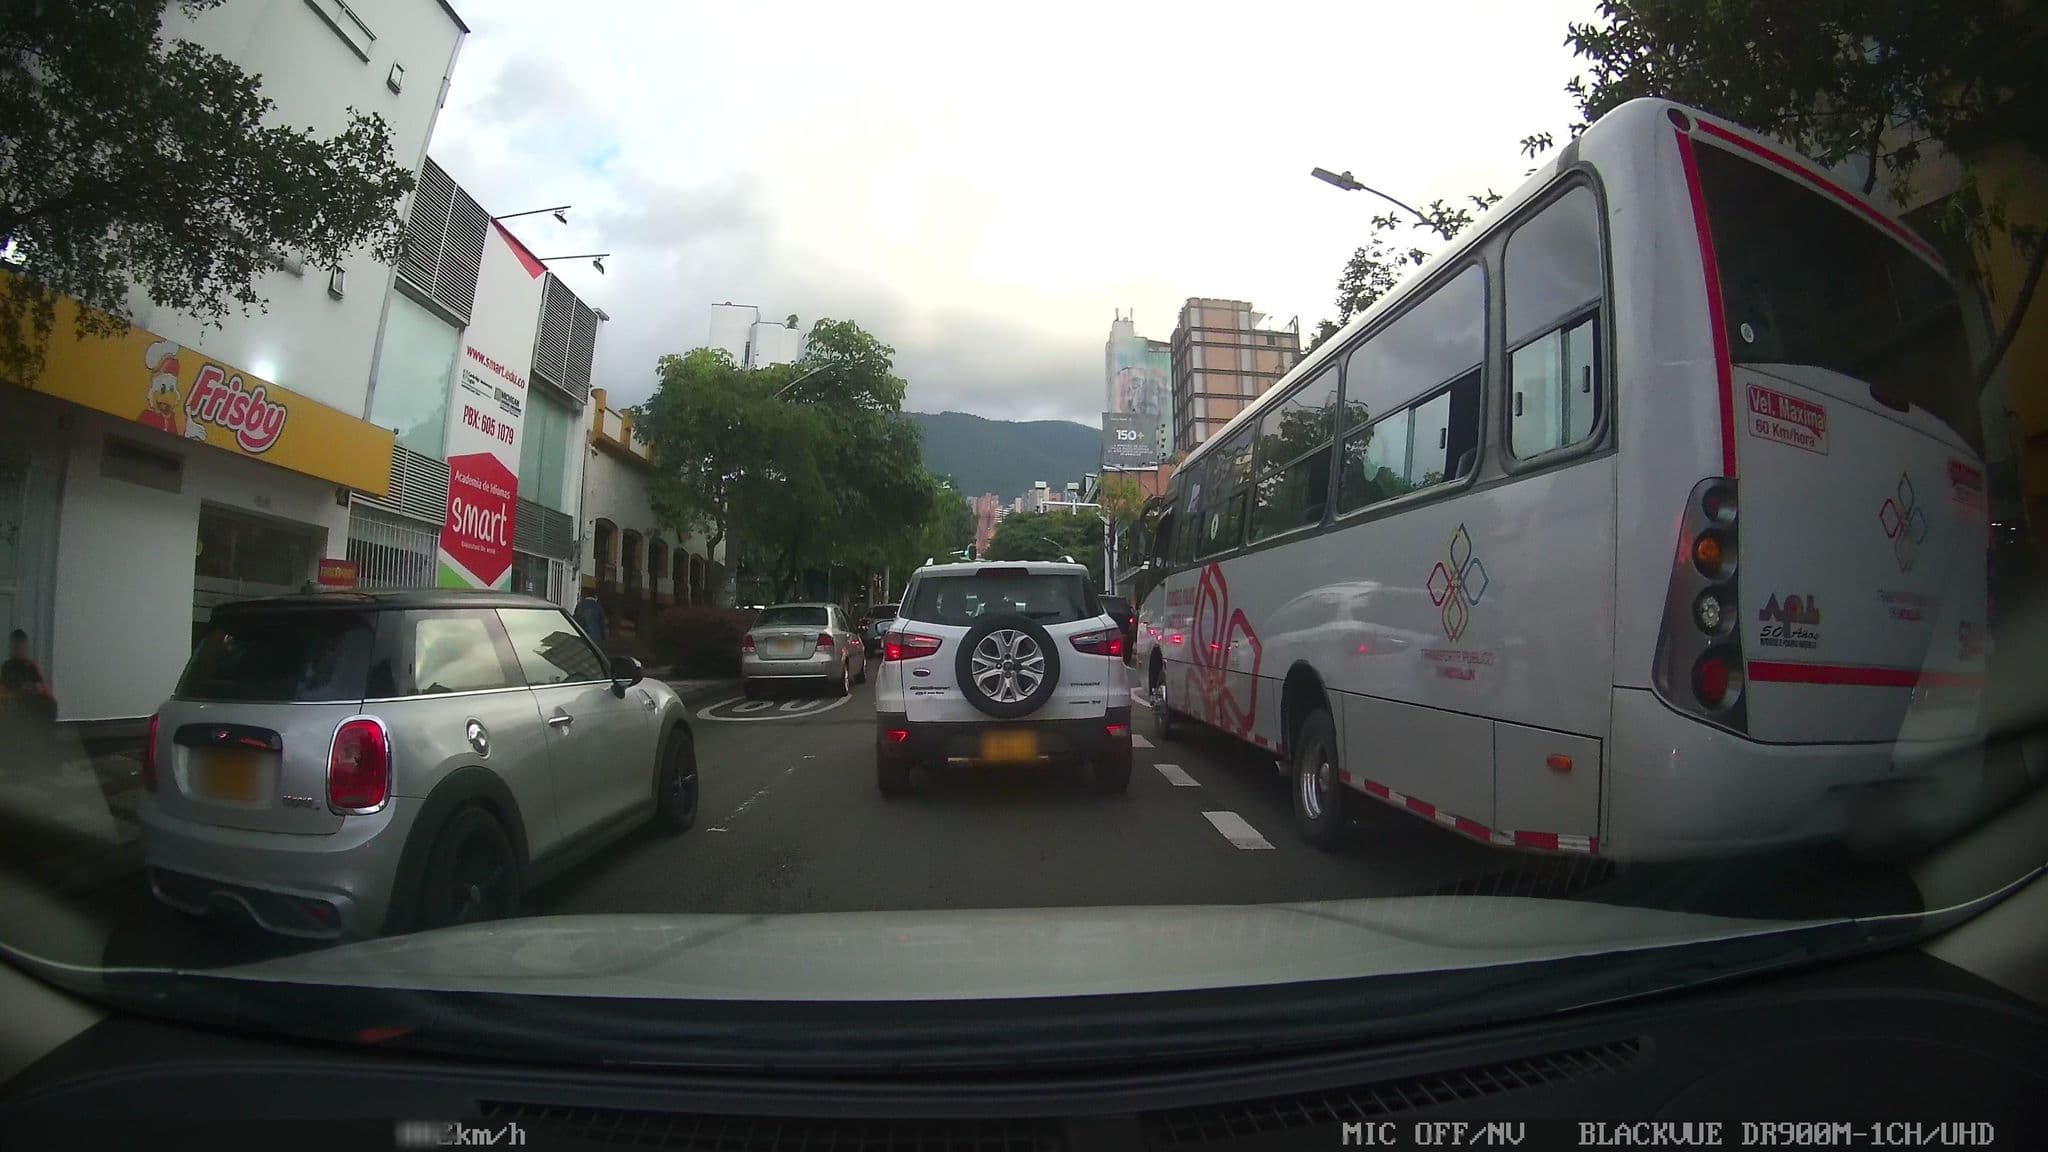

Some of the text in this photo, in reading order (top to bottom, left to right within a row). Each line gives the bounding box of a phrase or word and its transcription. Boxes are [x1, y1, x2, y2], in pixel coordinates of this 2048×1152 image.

[466, 345, 525, 389] www.smart.edu.co
[187, 364, 286, 452] Frisby
[463, 404, 480, 430] PBX:
[481, 414, 496, 436] 605
[497, 423, 514, 445] 1079
[1750, 388, 1826, 431] Vel. Maxima
[1756, 419, 1815, 447] 60 Km/hora
[455, 470, 511, 500] Academia de Idiomas
